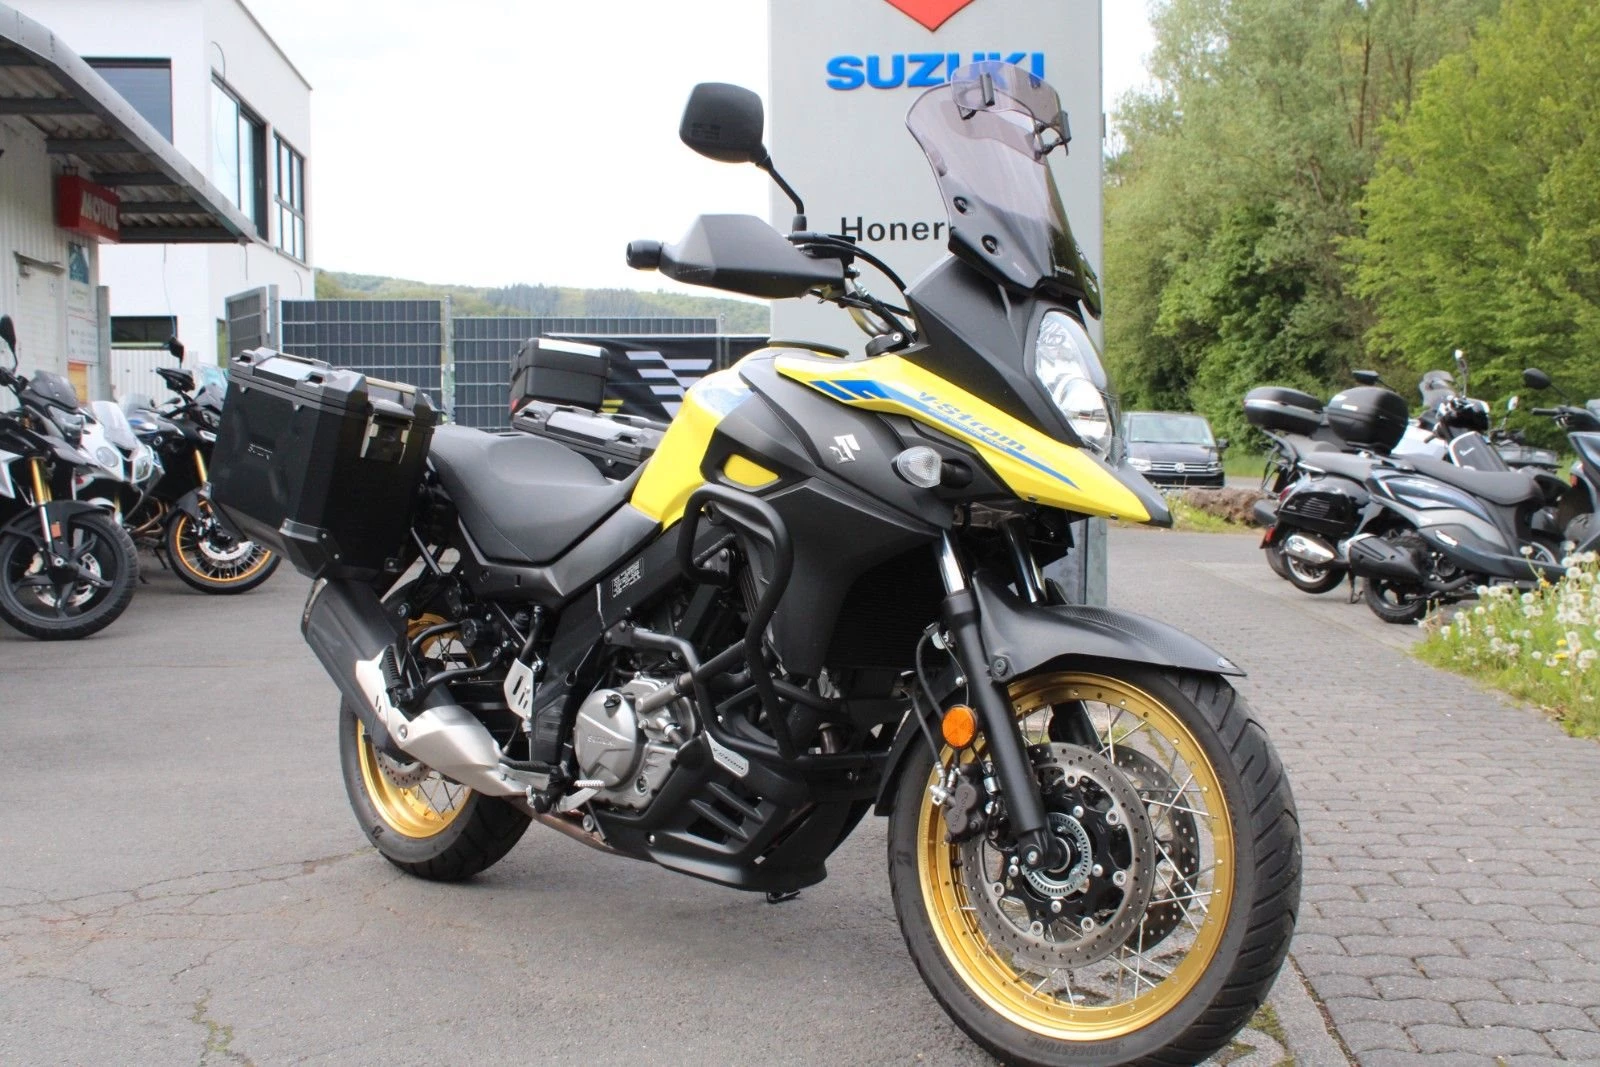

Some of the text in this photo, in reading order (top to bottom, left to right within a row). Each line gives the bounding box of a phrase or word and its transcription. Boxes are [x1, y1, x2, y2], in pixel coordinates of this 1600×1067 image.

[826, 52, 1045, 90] SUZUKI
[81, 190, 118, 231] MOTUL
[841, 216, 955, 241] Honer
